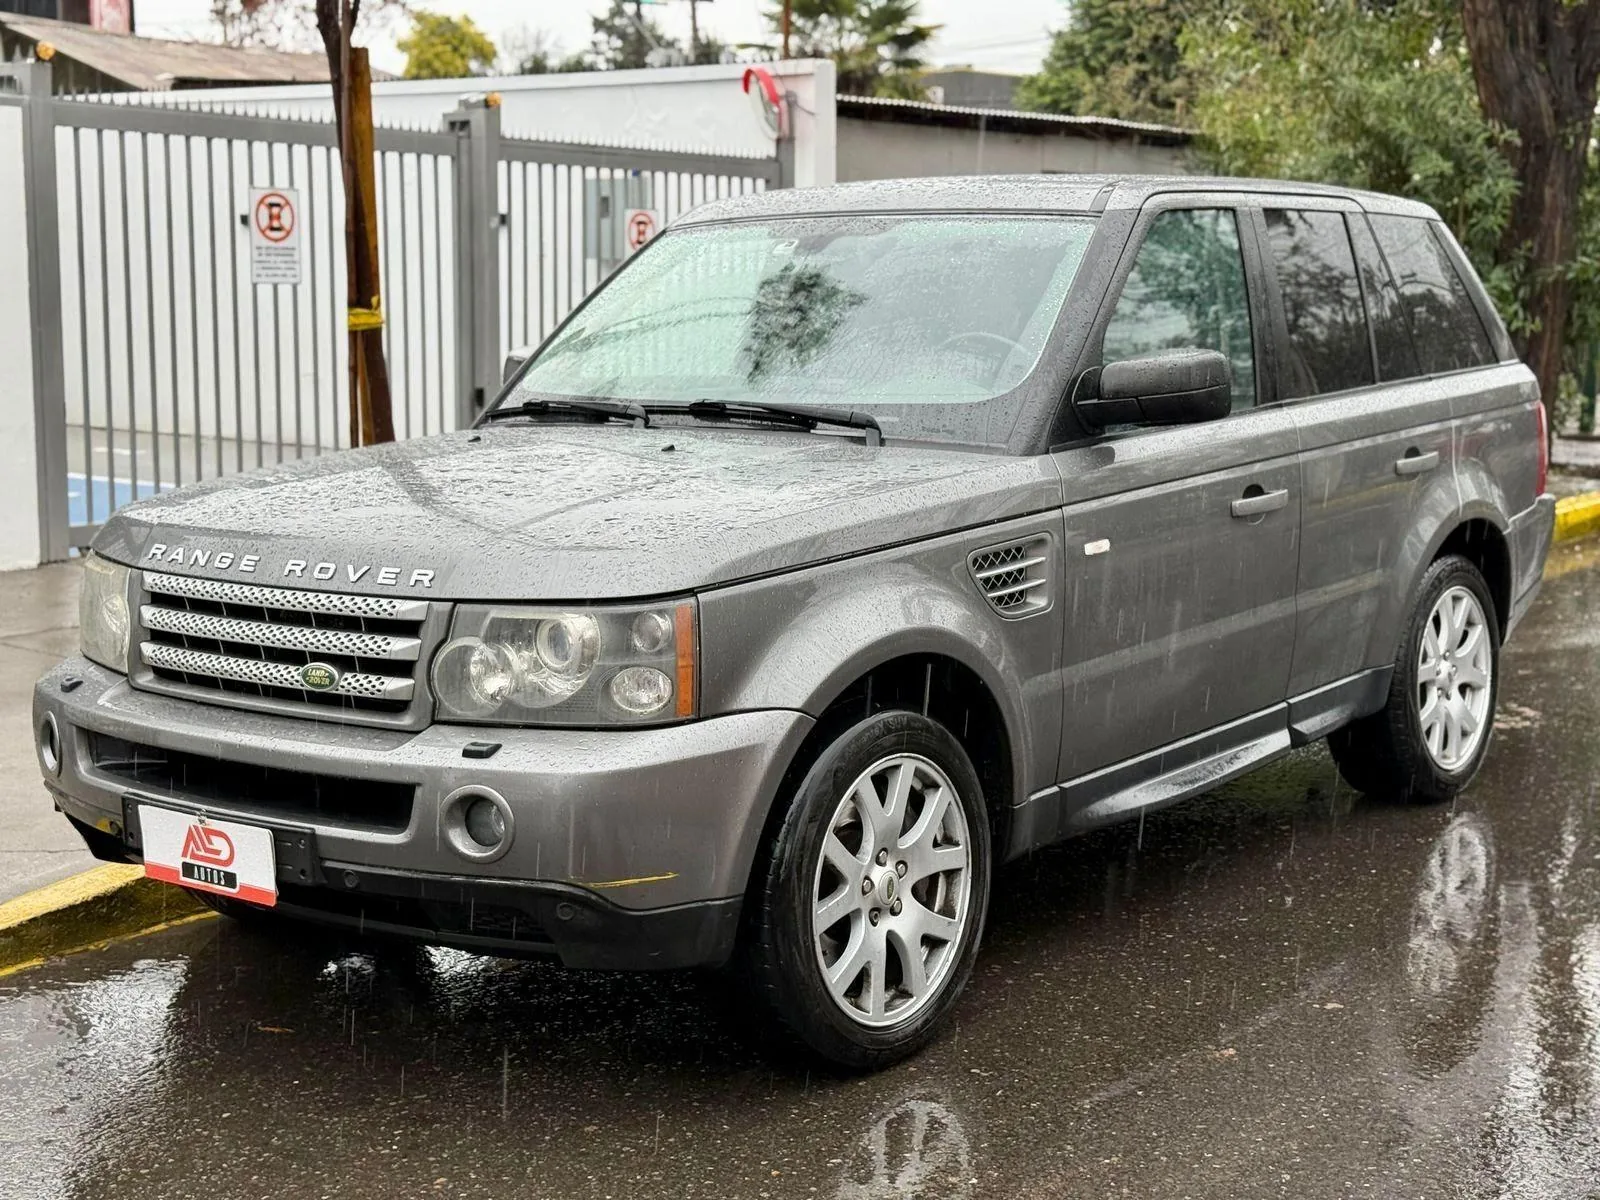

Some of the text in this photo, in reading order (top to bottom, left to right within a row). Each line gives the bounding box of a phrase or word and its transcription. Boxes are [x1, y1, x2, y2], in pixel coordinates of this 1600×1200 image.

[148, 543, 435, 588] RANGE ROVER
[308, 677, 330, 685] ROVER
[193, 865, 225, 886] AUTOS
